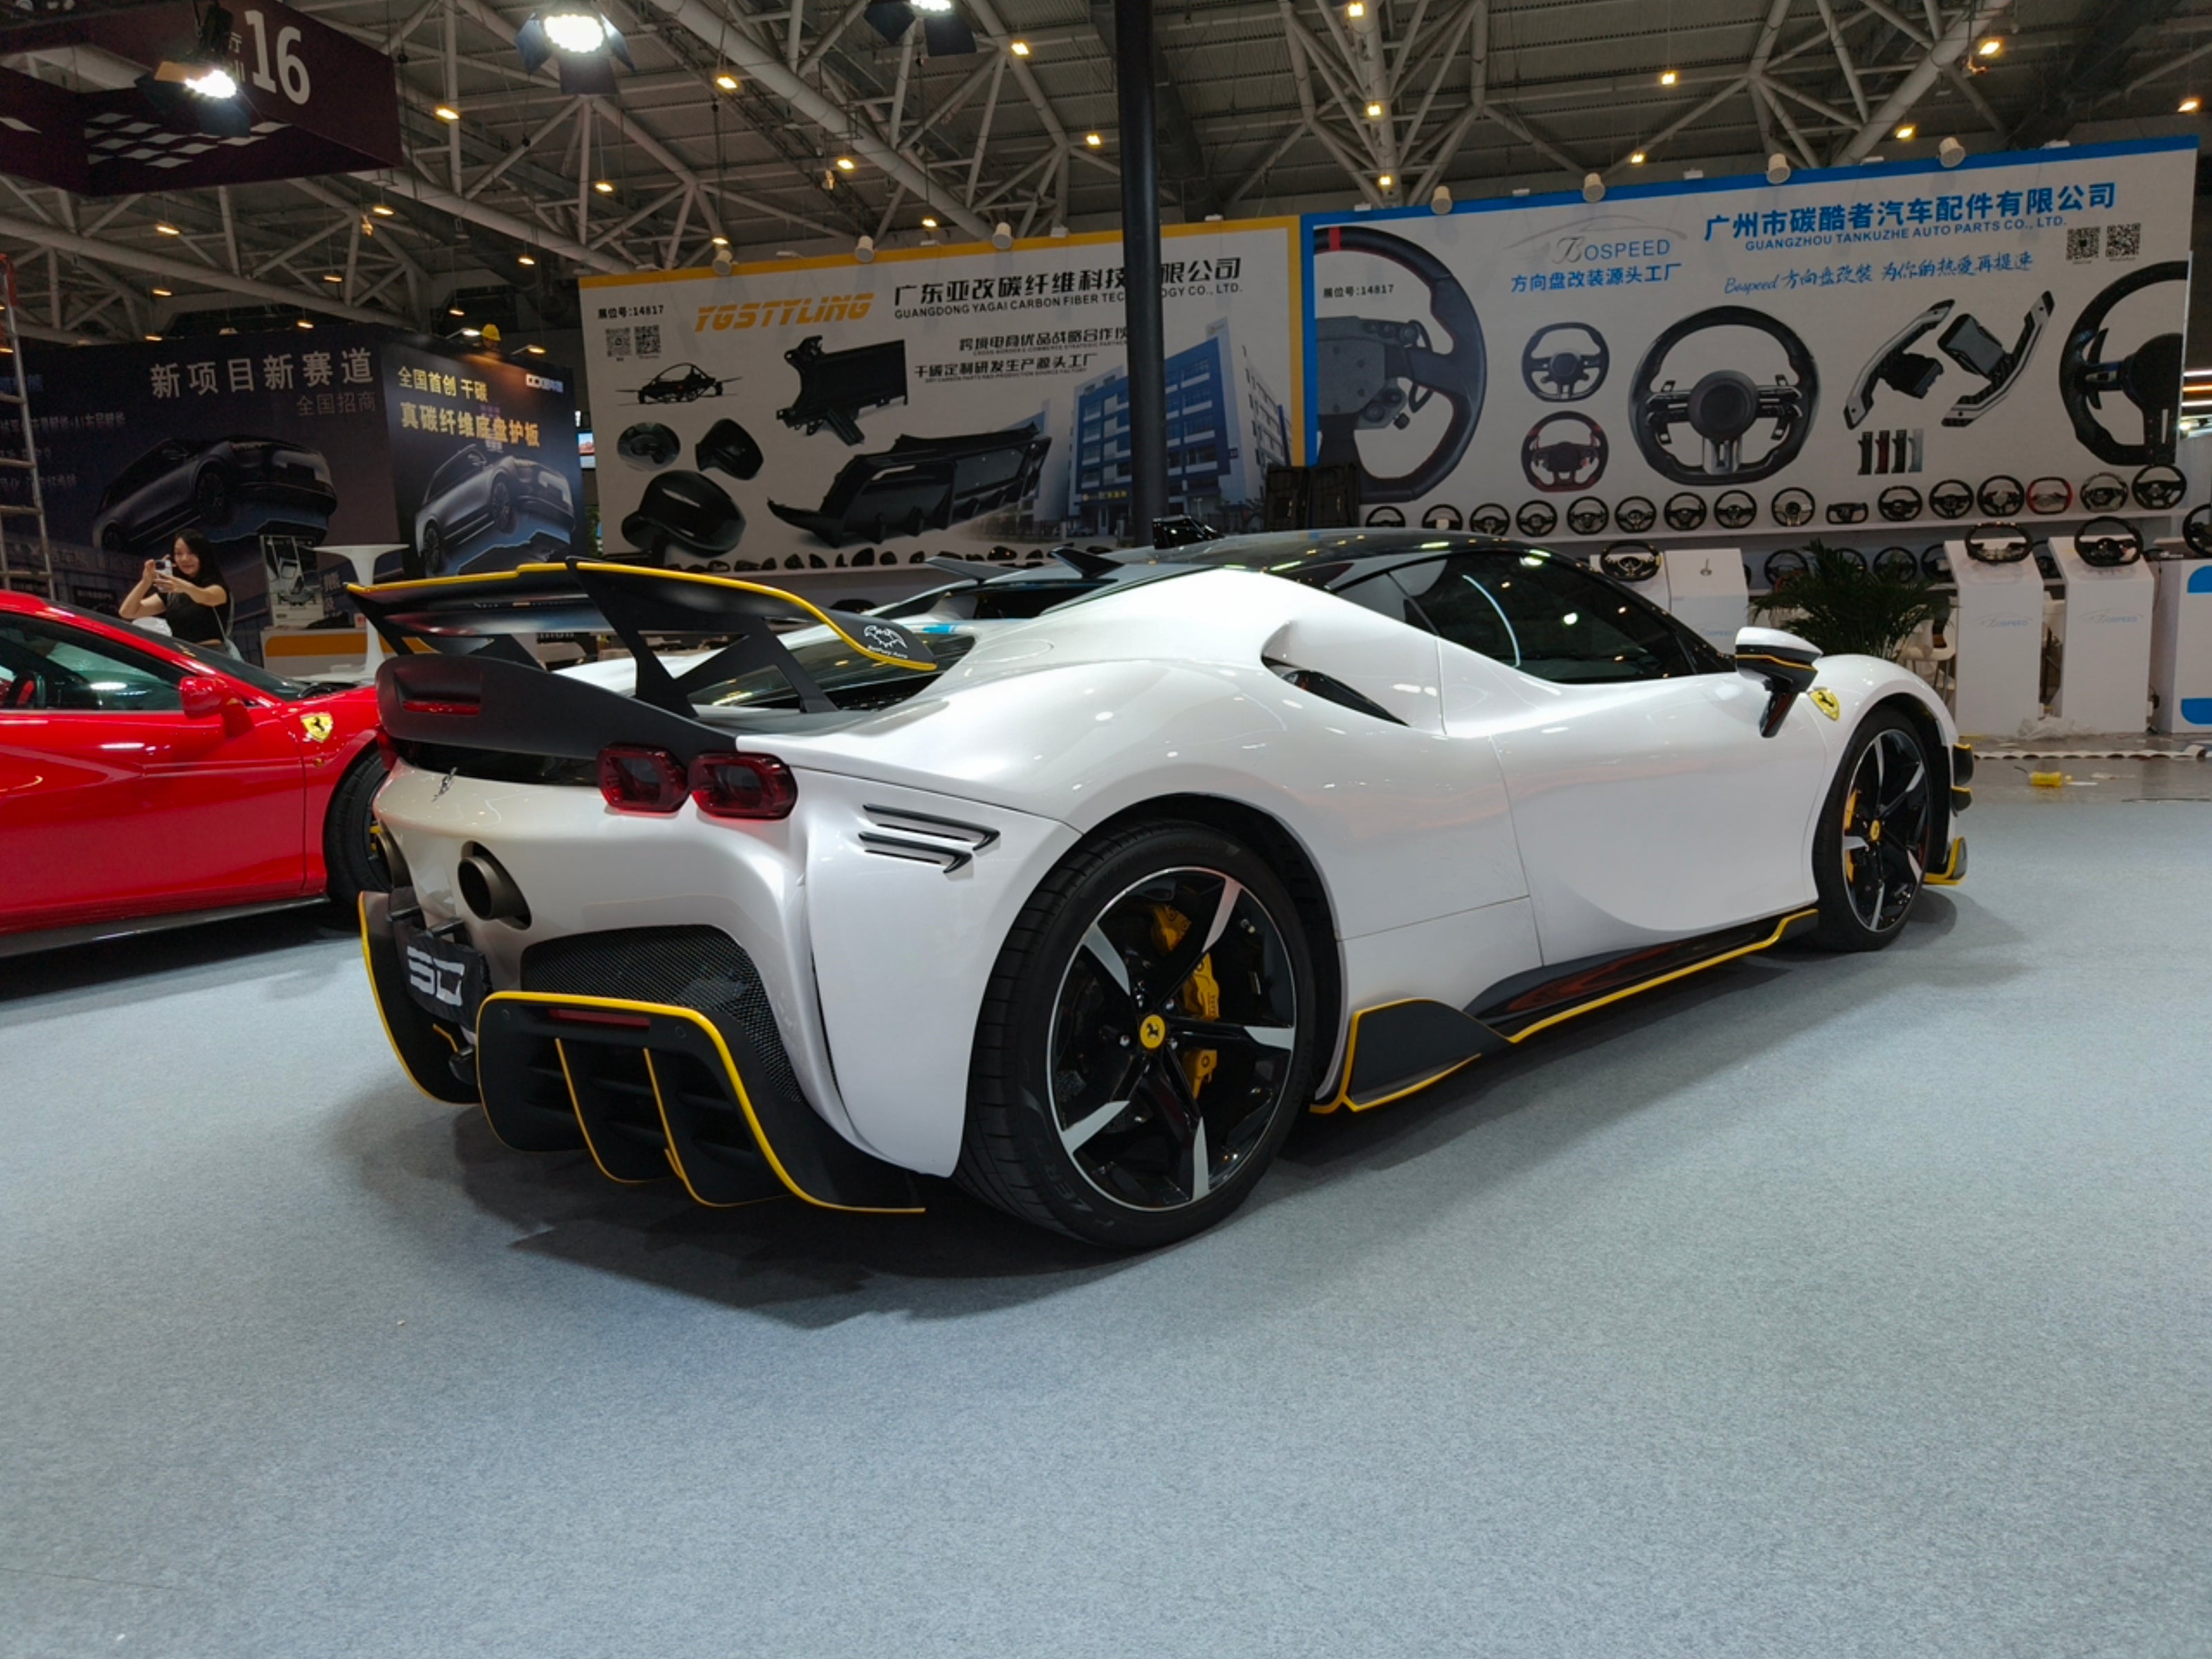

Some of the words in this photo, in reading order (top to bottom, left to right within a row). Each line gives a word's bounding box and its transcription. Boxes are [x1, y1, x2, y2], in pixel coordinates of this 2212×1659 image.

[244, 9, 311, 106] 16
[1703, 182, 2116, 241] 广州市碳酷者汽车配件有限公司
[1745, 234, 1833, 251] GUANGZHOU
[1836, 227, 1909, 244] TANKUZHE
[1912, 225, 1951, 238] AUTO
[1954, 221, 2000, 234] PARTS
[2003, 218, 2034, 231] CO.,
[2036, 216, 2067, 228] LTD.
[894, 256, 1241, 306] 广东亚改碳纤维科技限公司
[1322, 283, 1395, 299] 展位号:14817
[1510, 262, 1683, 294] 方向盘改装源头工厂
[695, 292, 875, 332] YGSTYLING
[894, 305, 971, 320] GUANGDONG
[972, 302, 1009, 313] YAGAI
[1010, 296, 1061, 310] CARBON
[1063, 292, 1099, 306] FIBER
[1102, 287, 1185, 303] TECOGY
[1216, 282, 1243, 294] LTD.
[149, 347, 374, 399] 新项目新赛道
[397, 366, 457, 397] 全国首创
[460, 378, 489, 402] 干碳
[296, 391, 376, 417] 全国招商
[400, 402, 541, 447] 真碳纤维底盘护板
